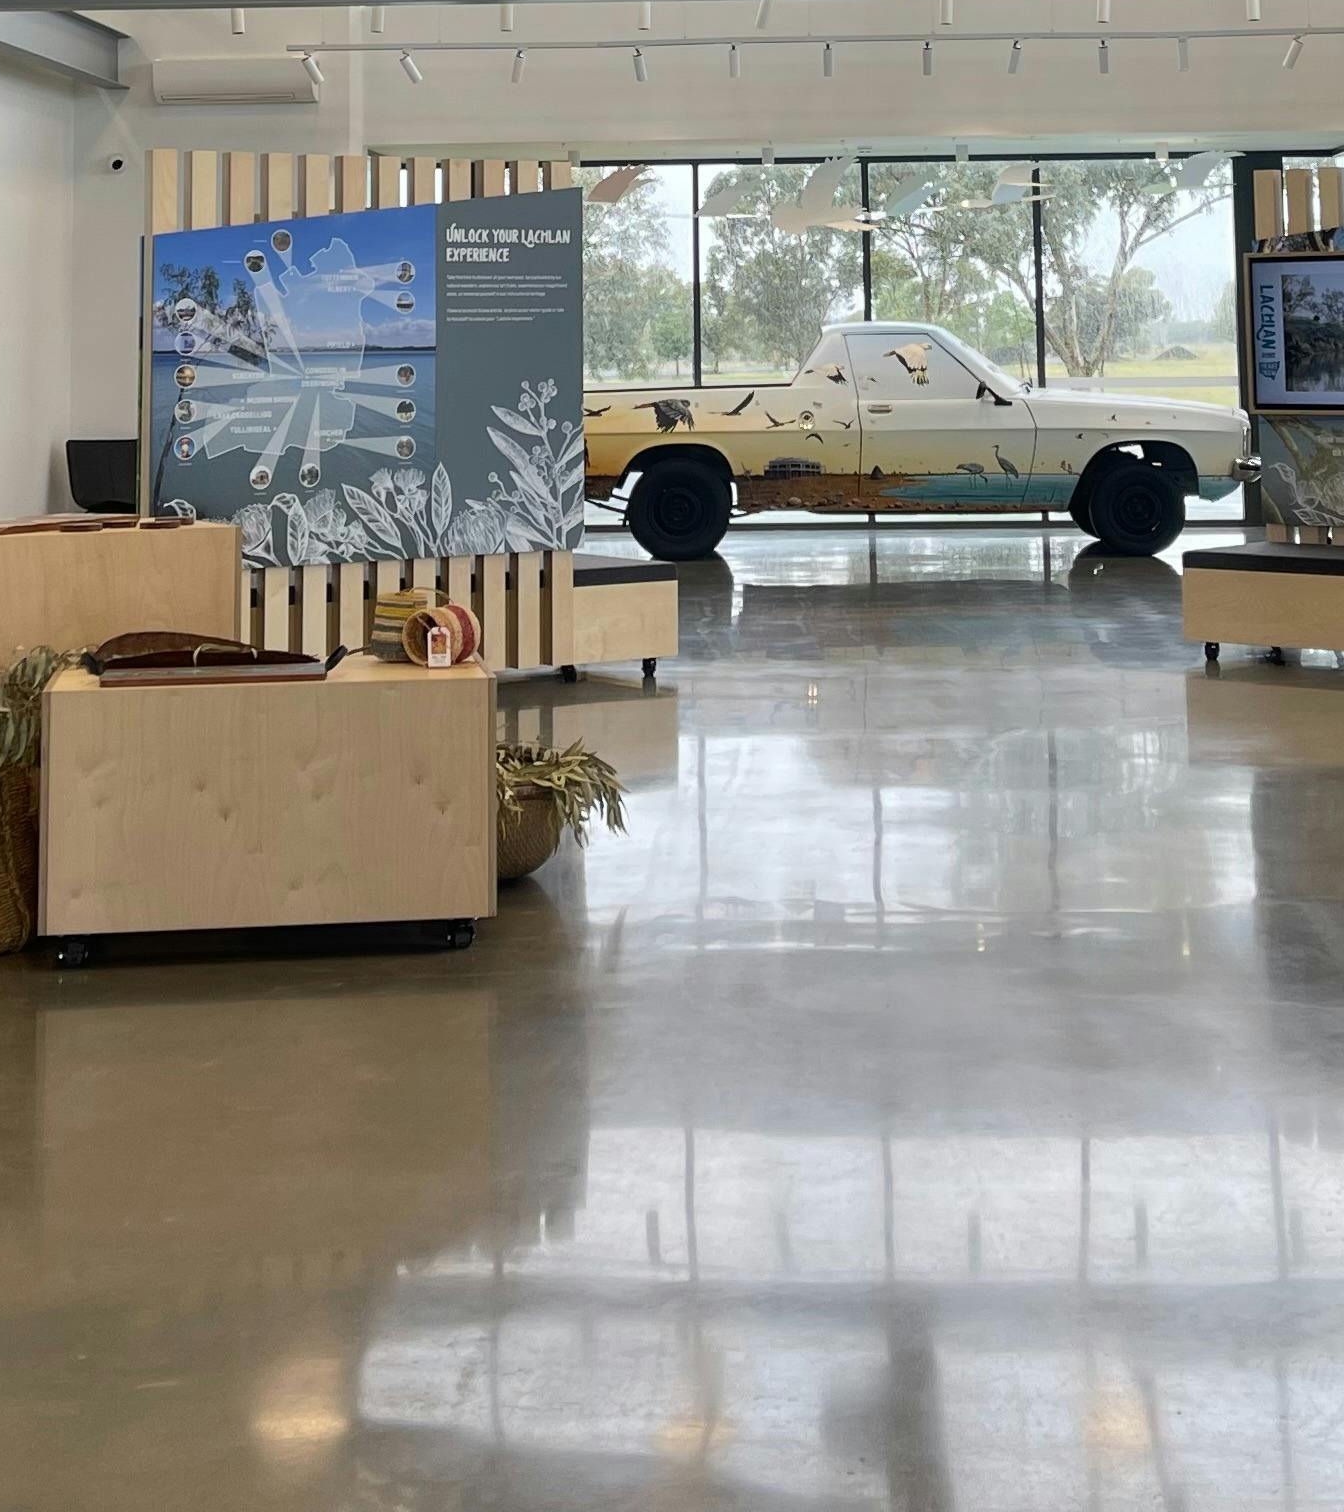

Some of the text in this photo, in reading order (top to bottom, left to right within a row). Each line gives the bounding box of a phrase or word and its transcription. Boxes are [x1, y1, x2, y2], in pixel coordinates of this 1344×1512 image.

[446, 222, 571, 248] UNLOCK YOUR LACHLAN
[446, 247, 510, 262] EXPERIENCE
[1256, 285, 1276, 349] LACHLAN
